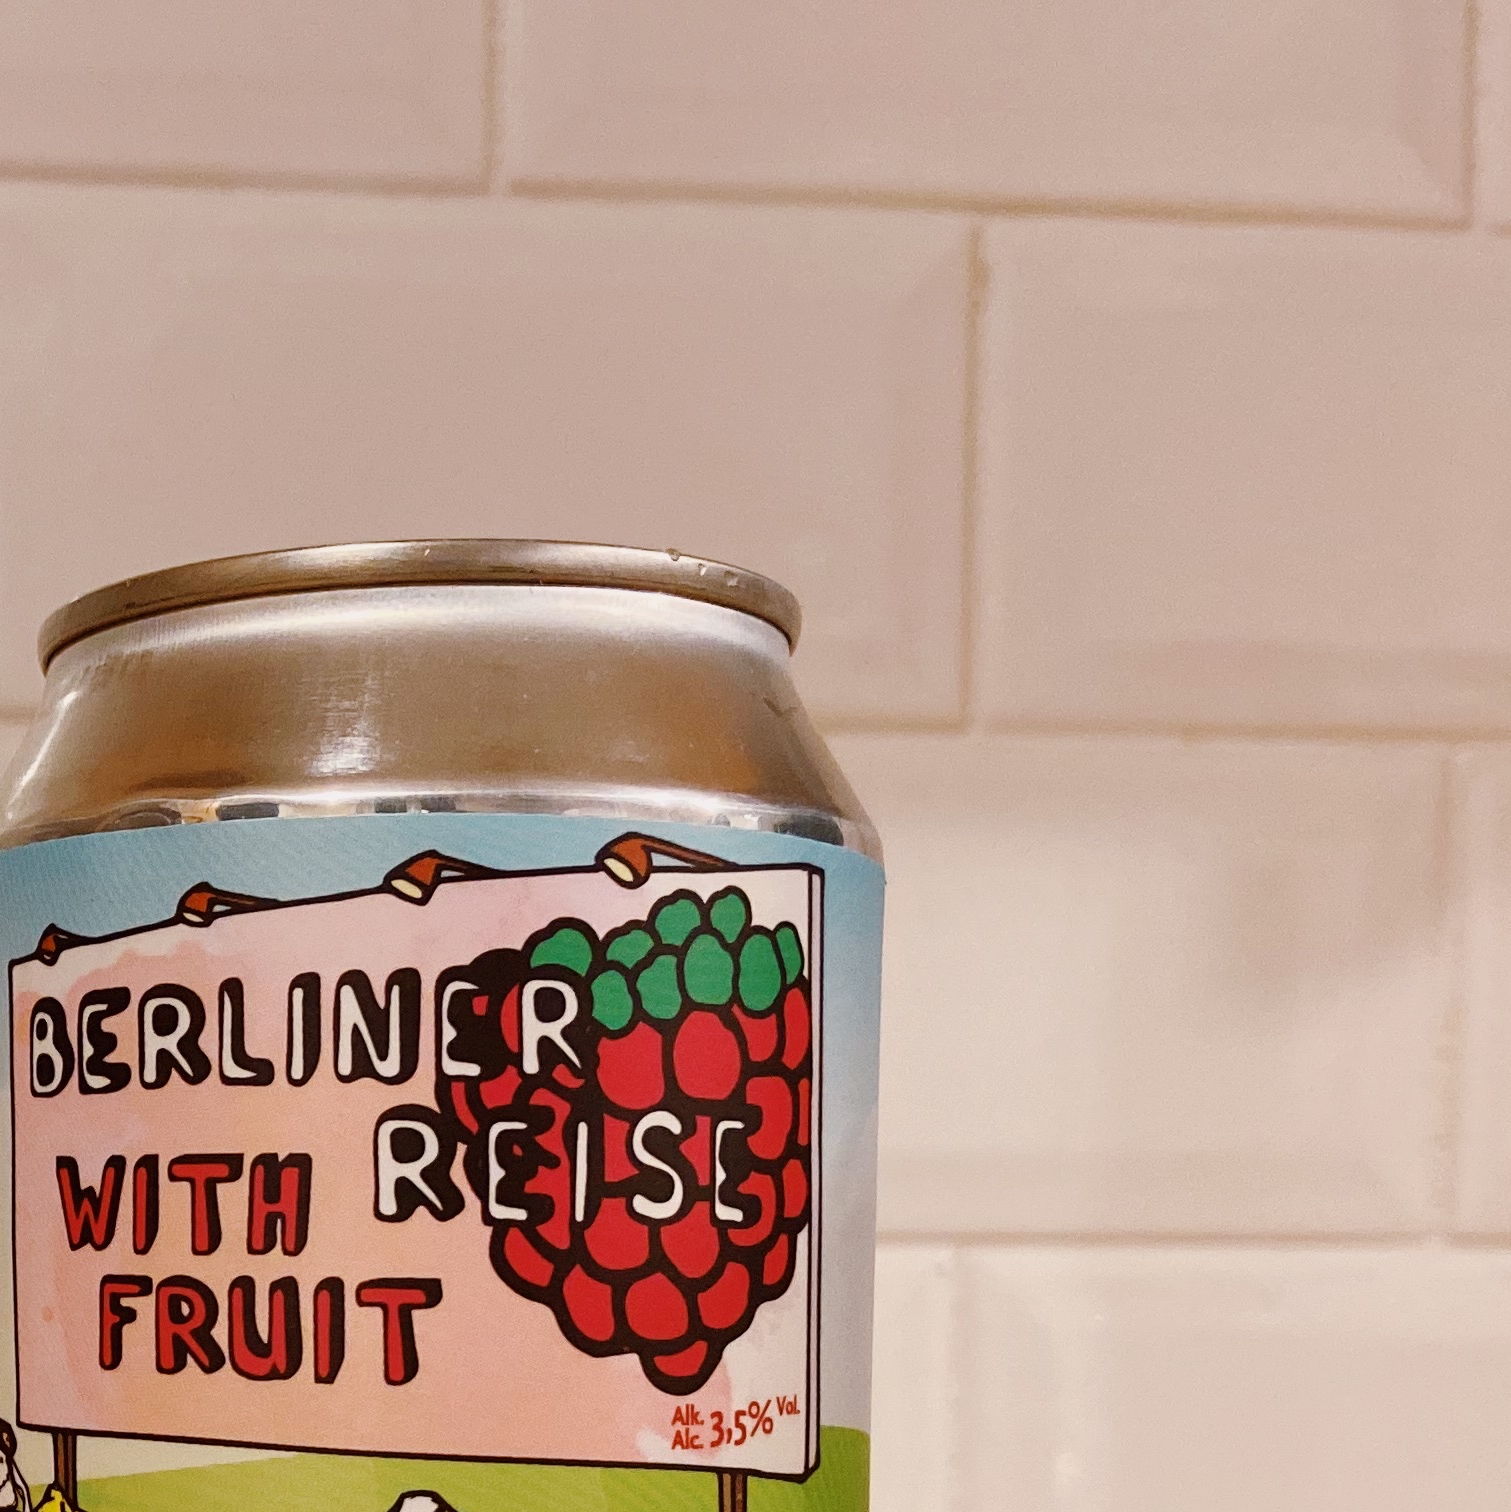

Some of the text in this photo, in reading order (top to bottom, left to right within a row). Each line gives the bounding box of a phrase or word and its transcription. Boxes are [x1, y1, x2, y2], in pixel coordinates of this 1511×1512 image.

[30, 966, 589, 1098] BERLINER
[56, 1152, 313, 1256] WITH
[373, 1106, 755, 1224] REISE
[98, 1275, 443, 1385] FRUIT
[671, 1394, 801, 1448] Alk. 3,5% Vol.
